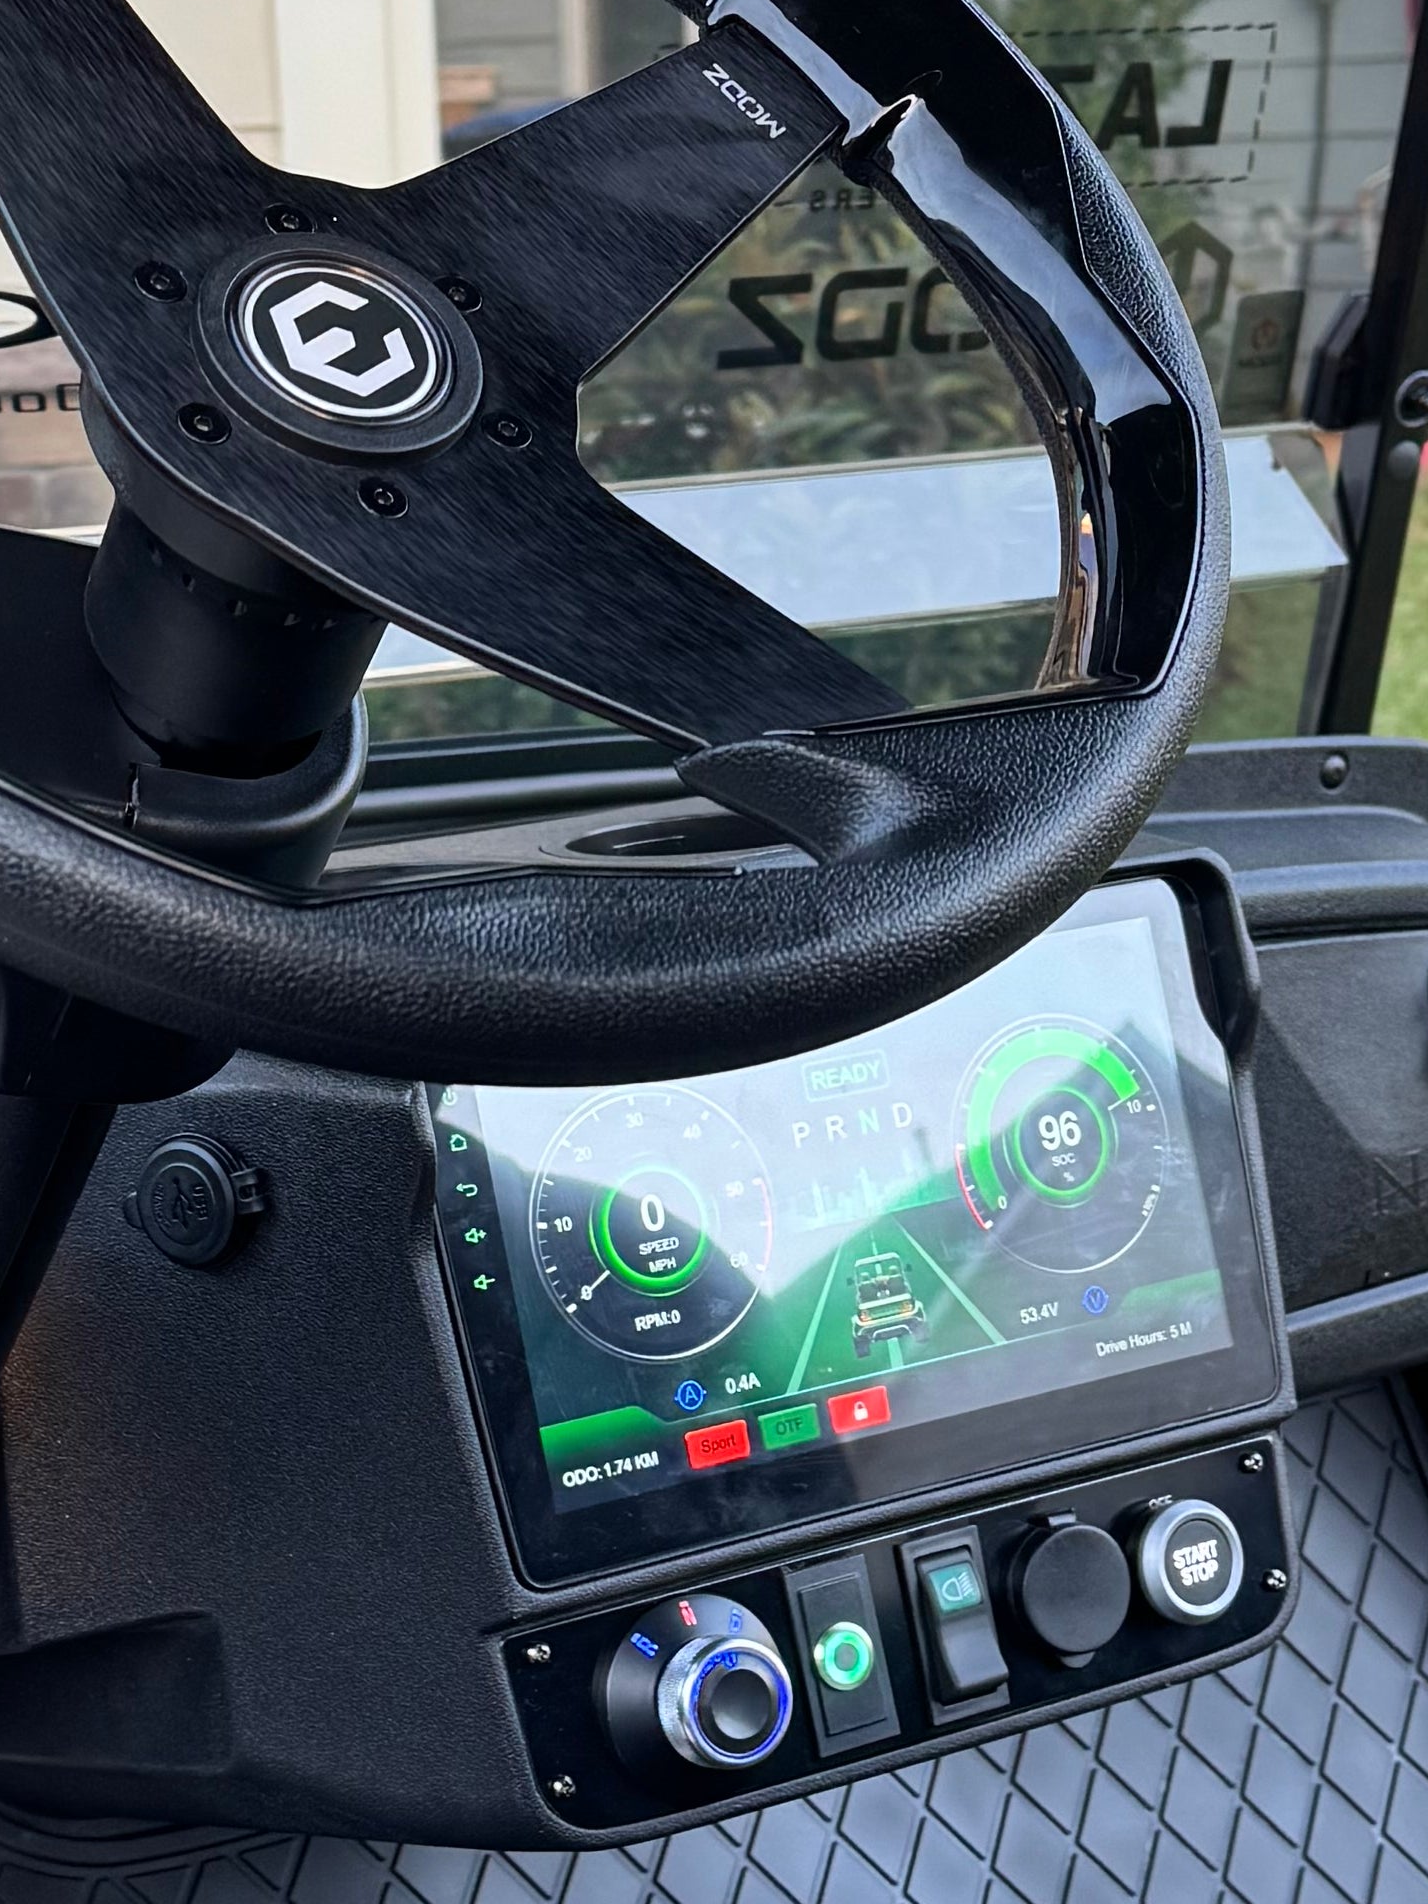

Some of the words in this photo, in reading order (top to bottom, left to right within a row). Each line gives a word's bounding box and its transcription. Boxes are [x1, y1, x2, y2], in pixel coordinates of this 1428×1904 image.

[702, 63, 787, 138] MODZ
[810, 1059, 881, 1091] READY
[625, 1113, 643, 1128] 30
[791, 1121, 810, 1148] P
[825, 1115, 848, 1142] R
[858, 1107, 880, 1135] N
[892, 1102, 912, 1128] D
[1038, 1110, 1082, 1150] 96
[574, 1147, 592, 1162] 20
[1051, 1152, 1076, 1166] SOC
[640, 1194, 665, 1232] 0
[554, 1216, 572, 1233] 10
[639, 1237, 679, 1255] SPEED
[649, 1257, 677, 1273] MPH
[730, 1252, 747, 1267] 60
[635, 1309, 681, 1331] RPM:0
[1020, 1302, 1059, 1324] 53.4V
[1096, 1339, 1127, 1356] Drive
[725, 1372, 761, 1395] 0.4A
[701, 1434, 736, 1455] Sport
[634, 1451, 659, 1469] KM
[1172, 1539, 1217, 1569] START
[1180, 1559, 1218, 1586] STOP
